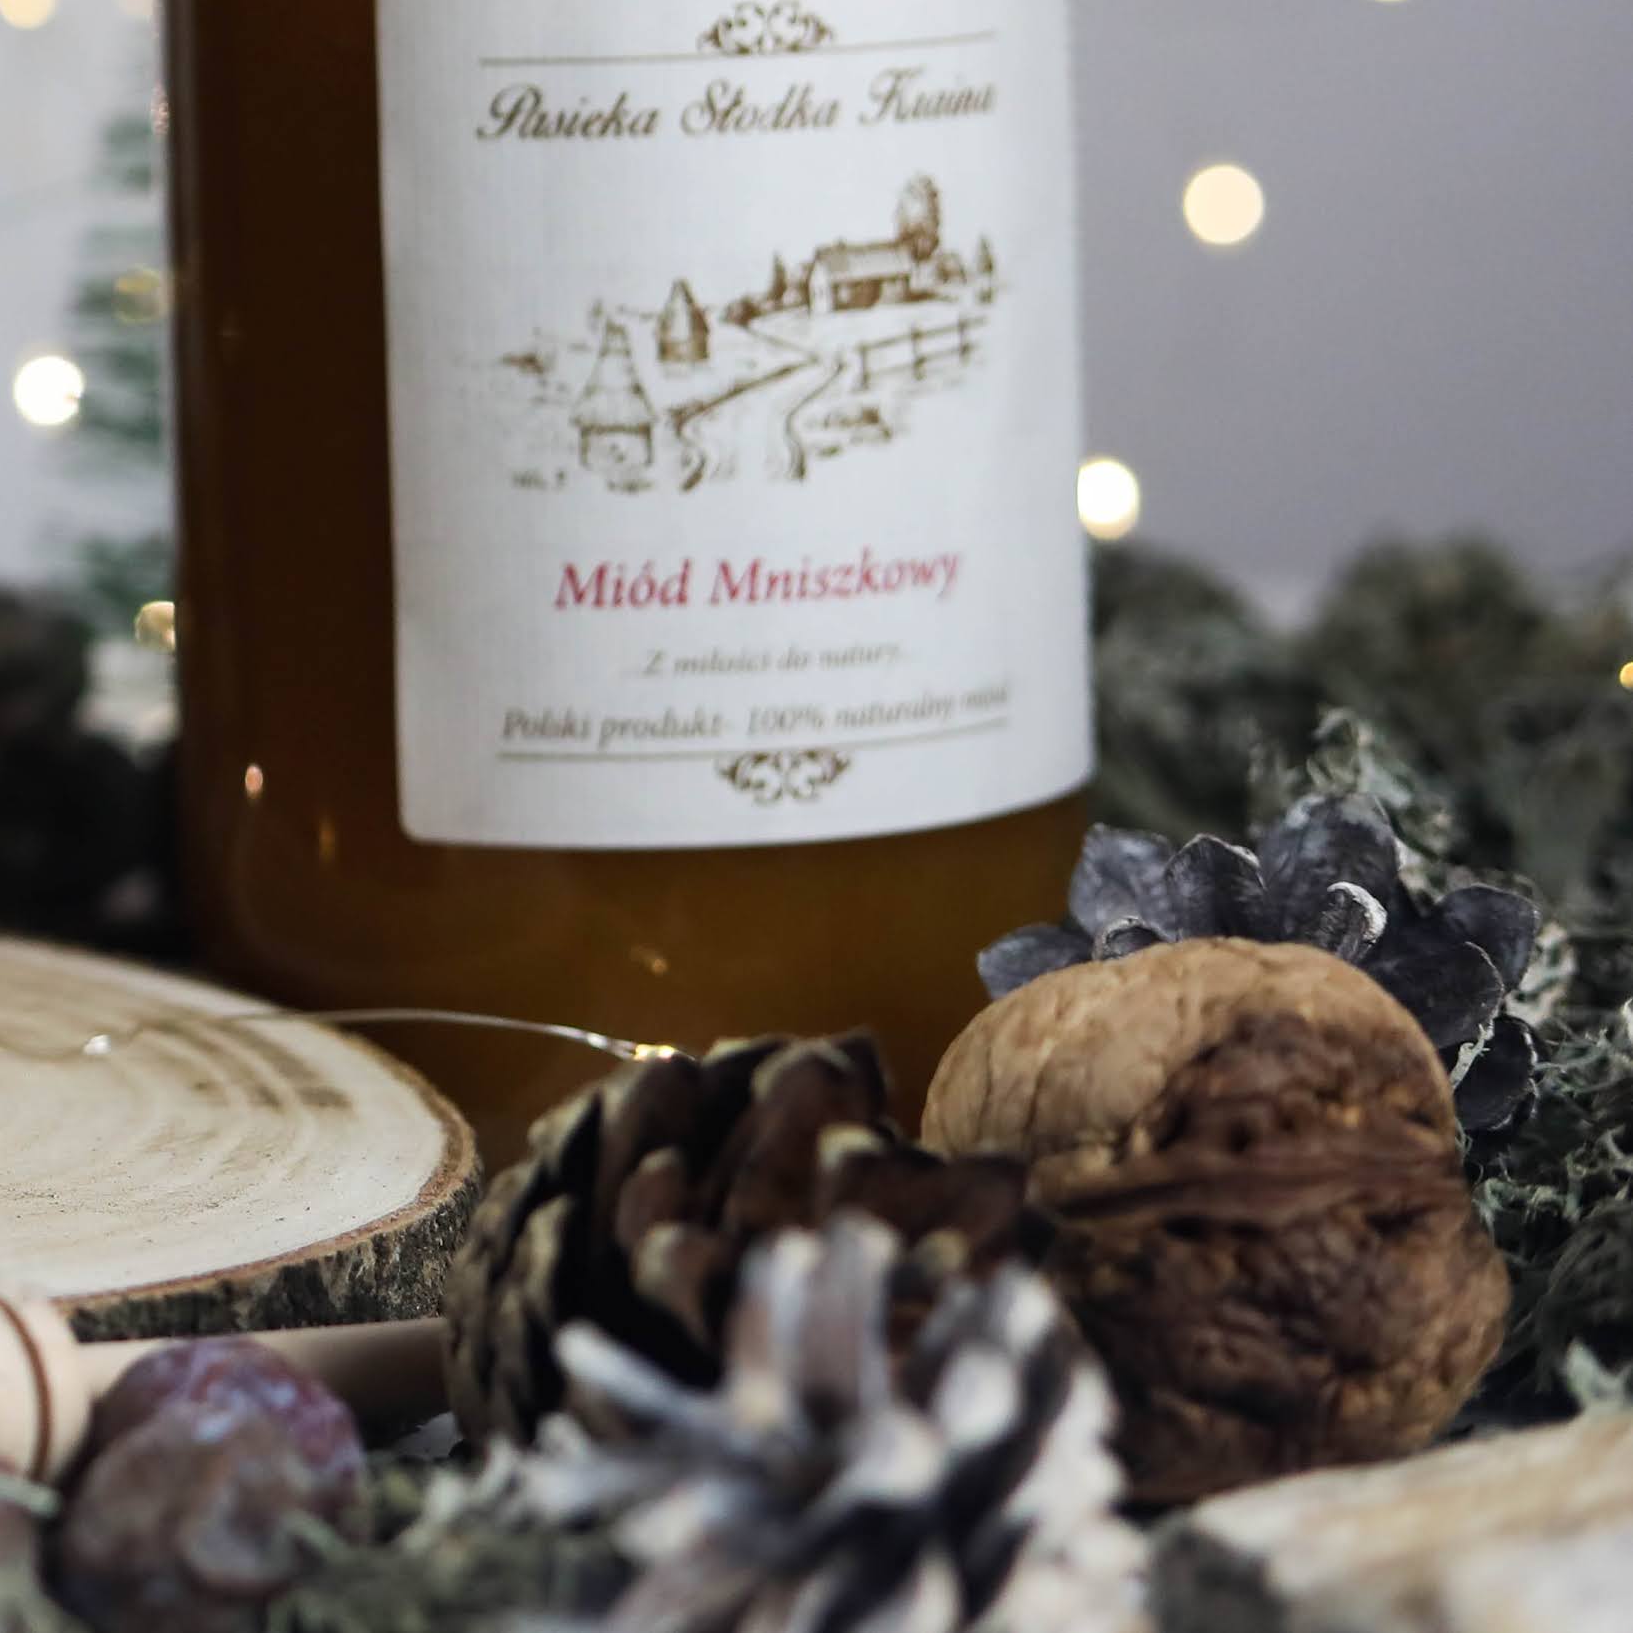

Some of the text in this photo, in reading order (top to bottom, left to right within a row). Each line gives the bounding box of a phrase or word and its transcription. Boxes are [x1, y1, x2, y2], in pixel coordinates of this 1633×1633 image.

[475, 82, 661, 143] Pasieka
[679, 77, 841, 138] Słodka
[553, 545, 961, 611] Miód Mniszkowy
[501, 705, 592, 743] Polski
[745, 701, 826, 737] 100%
